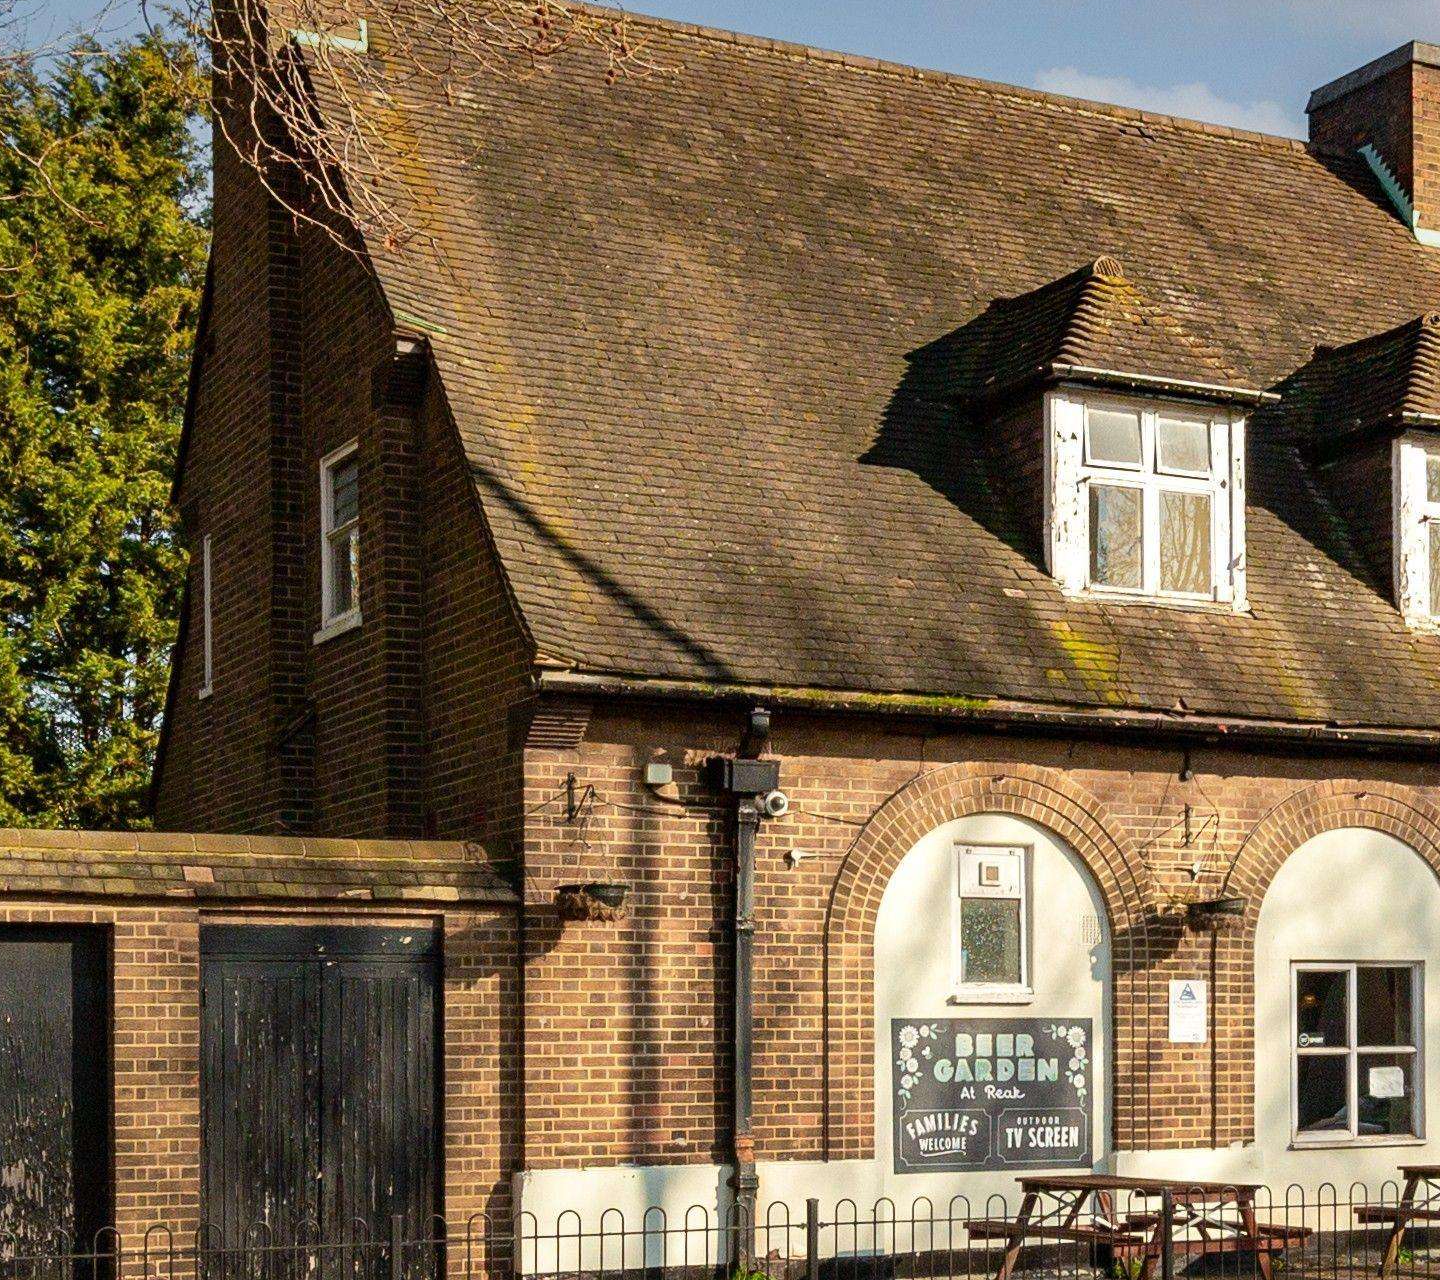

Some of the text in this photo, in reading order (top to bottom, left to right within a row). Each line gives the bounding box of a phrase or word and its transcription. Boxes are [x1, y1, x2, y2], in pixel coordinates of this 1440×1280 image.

[954, 1033, 1035, 1058] BEER
[933, 1058, 1059, 1083] GARDEN
[960, 1086, 976, 1100] At
[905, 1112, 979, 1141] FAMILIES
[1016, 1116, 1060, 1126] OUTDOOR
[918, 1136, 967, 1152] WELCOME
[1005, 1126, 1079, 1149] TV SCREEN
